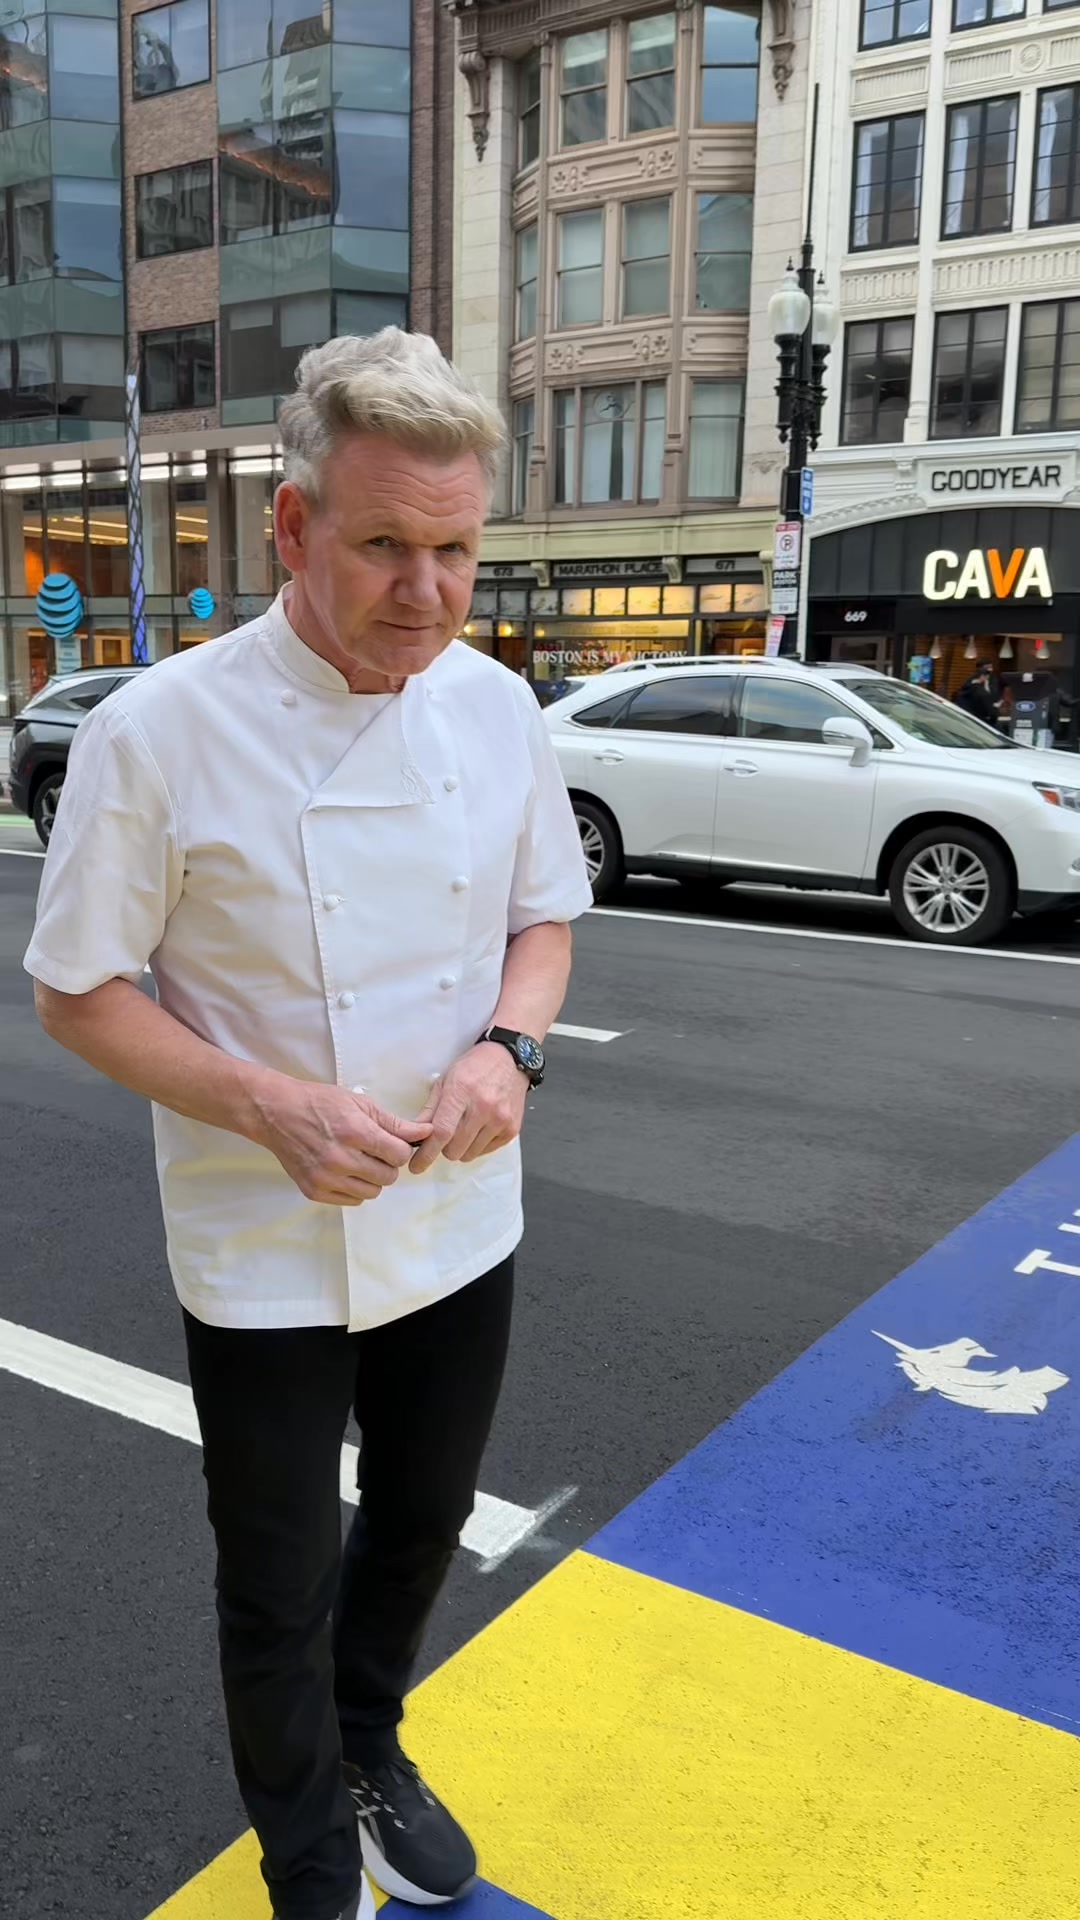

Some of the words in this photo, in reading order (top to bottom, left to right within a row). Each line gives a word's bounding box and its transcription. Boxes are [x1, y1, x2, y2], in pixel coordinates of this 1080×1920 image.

[931, 465, 1061, 491] GOODYEAR
[493, 567, 514, 577] 673
[559, 563, 620, 575] MARATHON
[624, 561, 663, 573] PLACE
[715, 560, 736, 570] 671
[923, 547, 1052, 600] CAVA
[844, 610, 868, 622] 669
[533, 650, 583, 664] BOSTON
[586, 650, 600, 664] IS
[602, 650, 623, 664] MY
